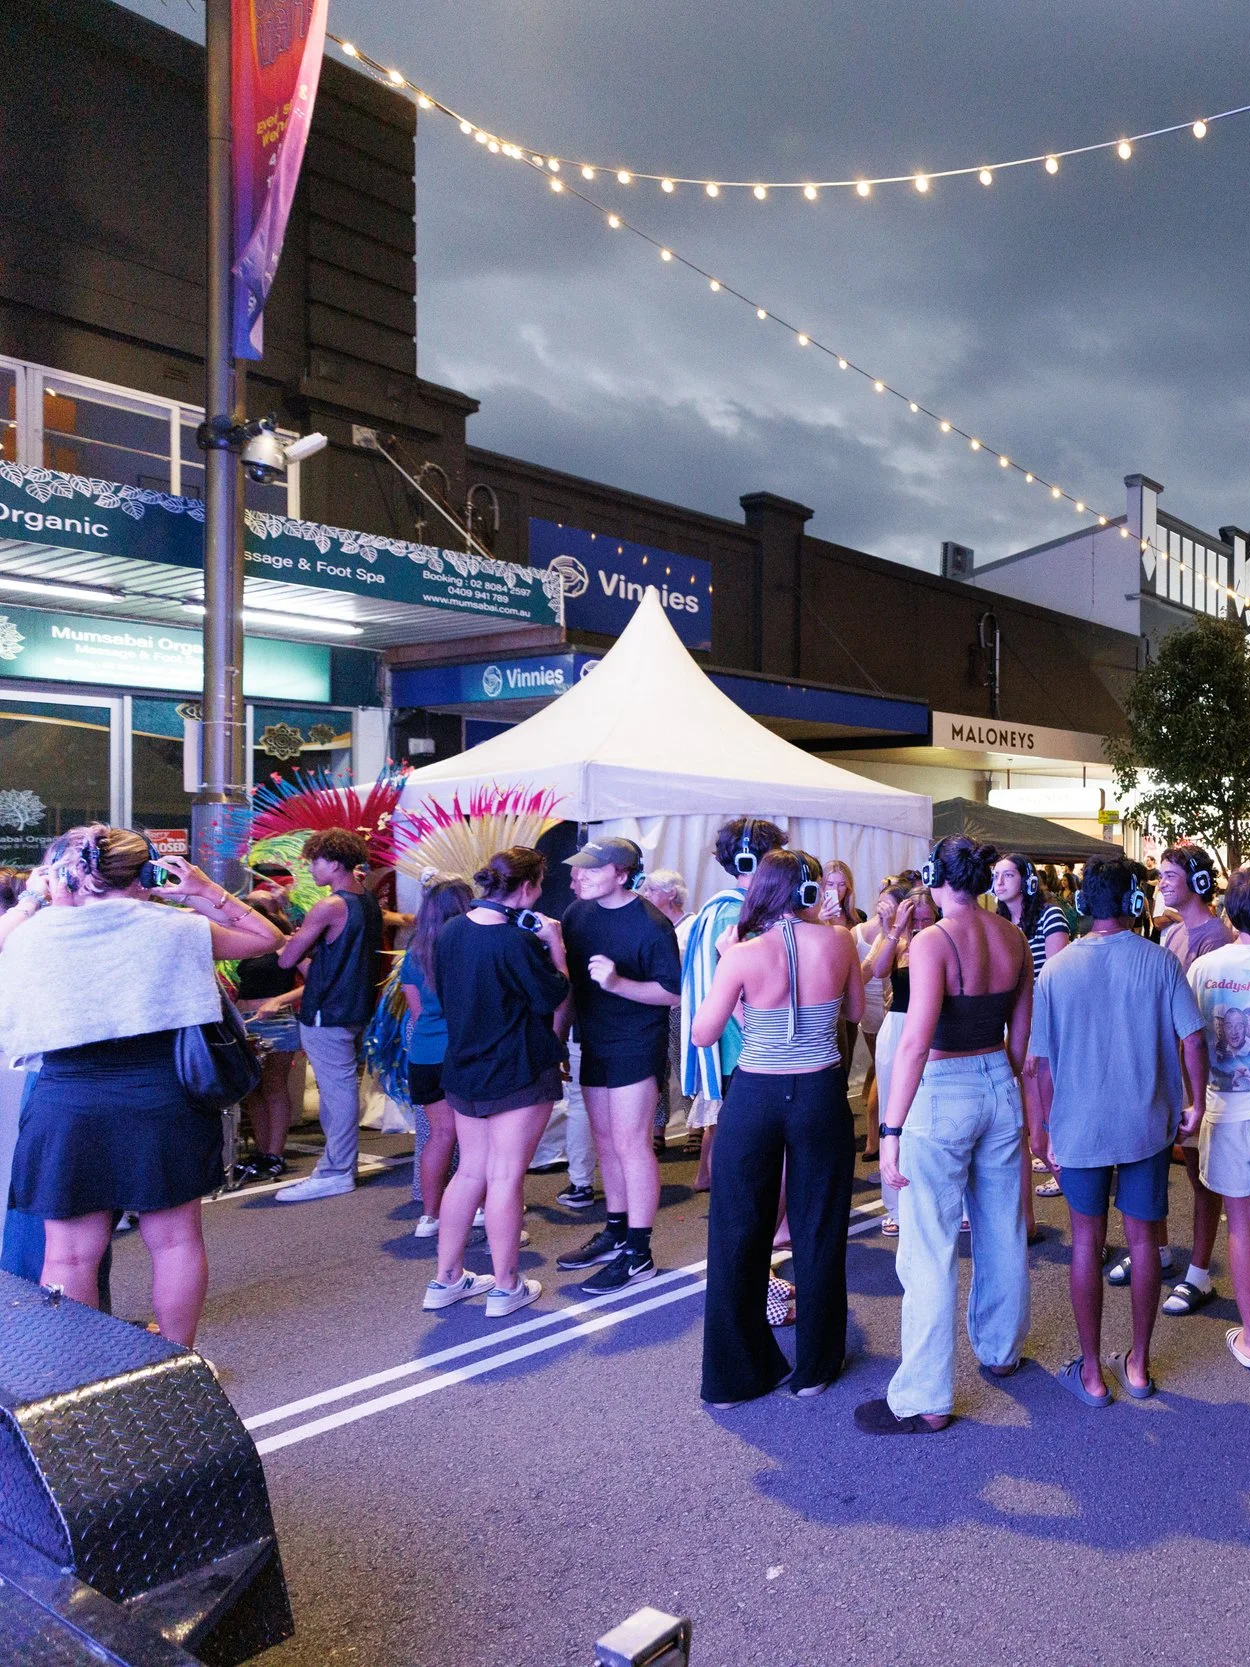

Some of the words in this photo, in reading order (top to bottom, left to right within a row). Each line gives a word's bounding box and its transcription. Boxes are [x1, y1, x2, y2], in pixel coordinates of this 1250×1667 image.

[0, 503, 109, 538] Organic
[298, 558, 311, 571] &
[316, 561, 352, 578] Foot
[355, 568, 386, 584] Spa
[423, 570, 463, 587] Booking
[470, 579, 483, 589] 02
[484, 582, 508, 593] 8084
[447, 586, 473, 597] 0409
[474, 590, 490, 600] 941
[423, 594, 531, 618] www.mumsabai.com.au
[51, 625, 153, 648] Mumsabai
[506, 666, 564, 689] Vinnies
[951, 723, 1034, 749] MALONEYS
